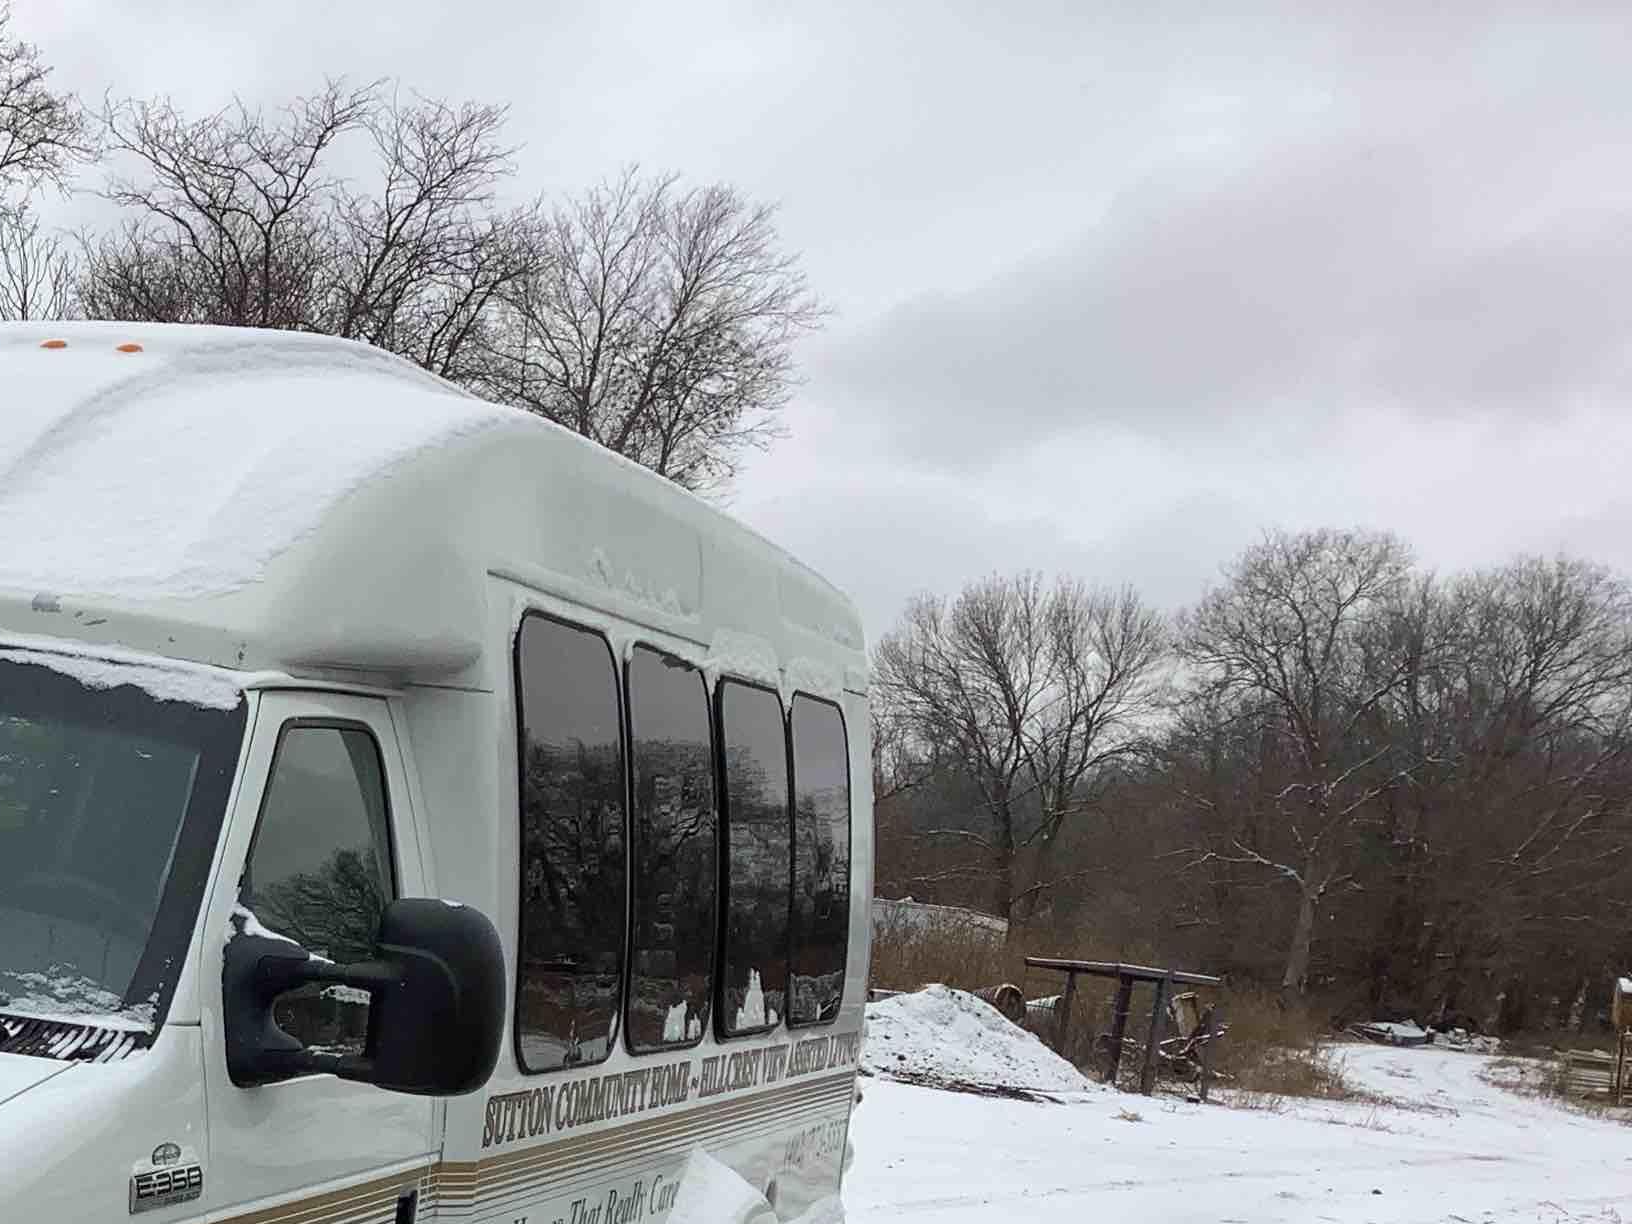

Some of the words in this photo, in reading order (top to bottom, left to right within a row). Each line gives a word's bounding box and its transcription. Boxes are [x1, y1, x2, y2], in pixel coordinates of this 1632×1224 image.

[481, 1086, 556, 1149] SUTTON
[556, 1068, 650, 1130] COMMUNITY
[648, 1061, 691, 1109] HOME
